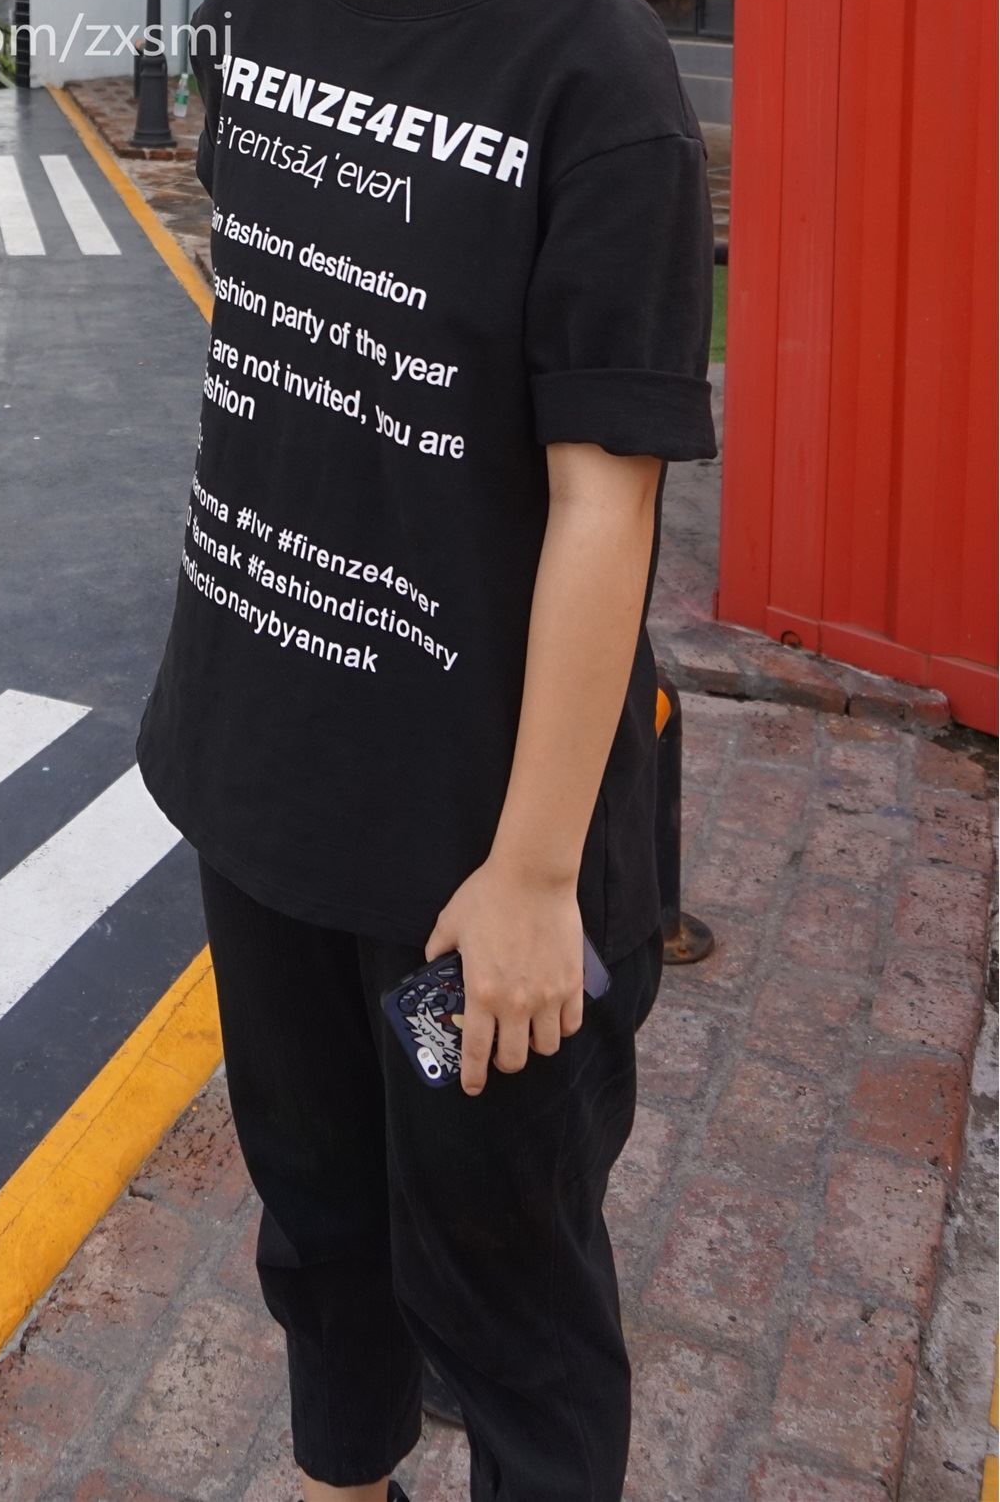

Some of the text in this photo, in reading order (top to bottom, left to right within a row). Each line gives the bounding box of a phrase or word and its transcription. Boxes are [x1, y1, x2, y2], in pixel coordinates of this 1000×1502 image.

[221, 54, 530, 188] IRENZE4EVER
[224, 213, 294, 261] fashion
[299, 242, 427, 311] destination
[214, 267, 459, 389] ashion party of the year
[212, 338, 239, 370] are
[242, 354, 281, 387] not
[284, 363, 367, 425] invited,
[375, 404, 412, 447] you
[418, 430, 465, 459] are
[236, 506, 274, 544] #lvr
[277, 528, 440, 618] #firenze4ever
[247, 553, 459, 672] #fashiondictionary
